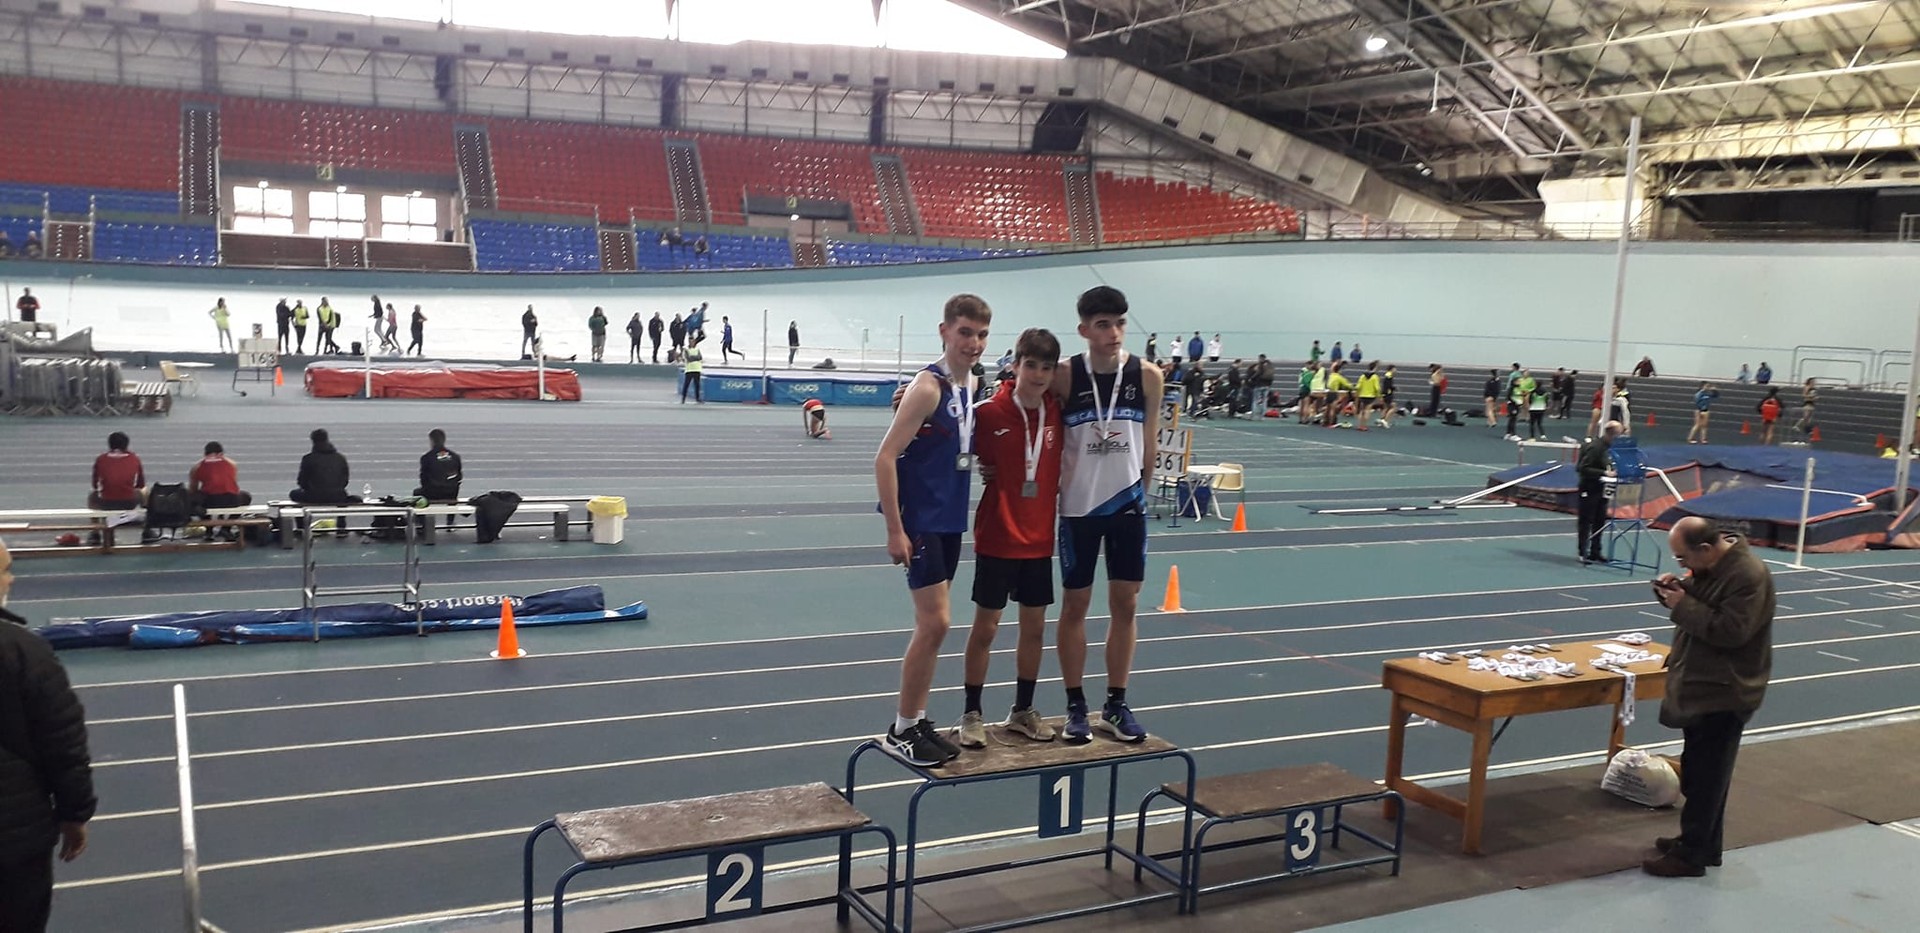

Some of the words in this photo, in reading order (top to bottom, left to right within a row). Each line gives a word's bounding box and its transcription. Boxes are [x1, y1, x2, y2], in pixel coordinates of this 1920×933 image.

[1053, 775, 1071, 828] 1
[1290, 810, 1317, 860] 3
[714, 853, 754, 914] 2
